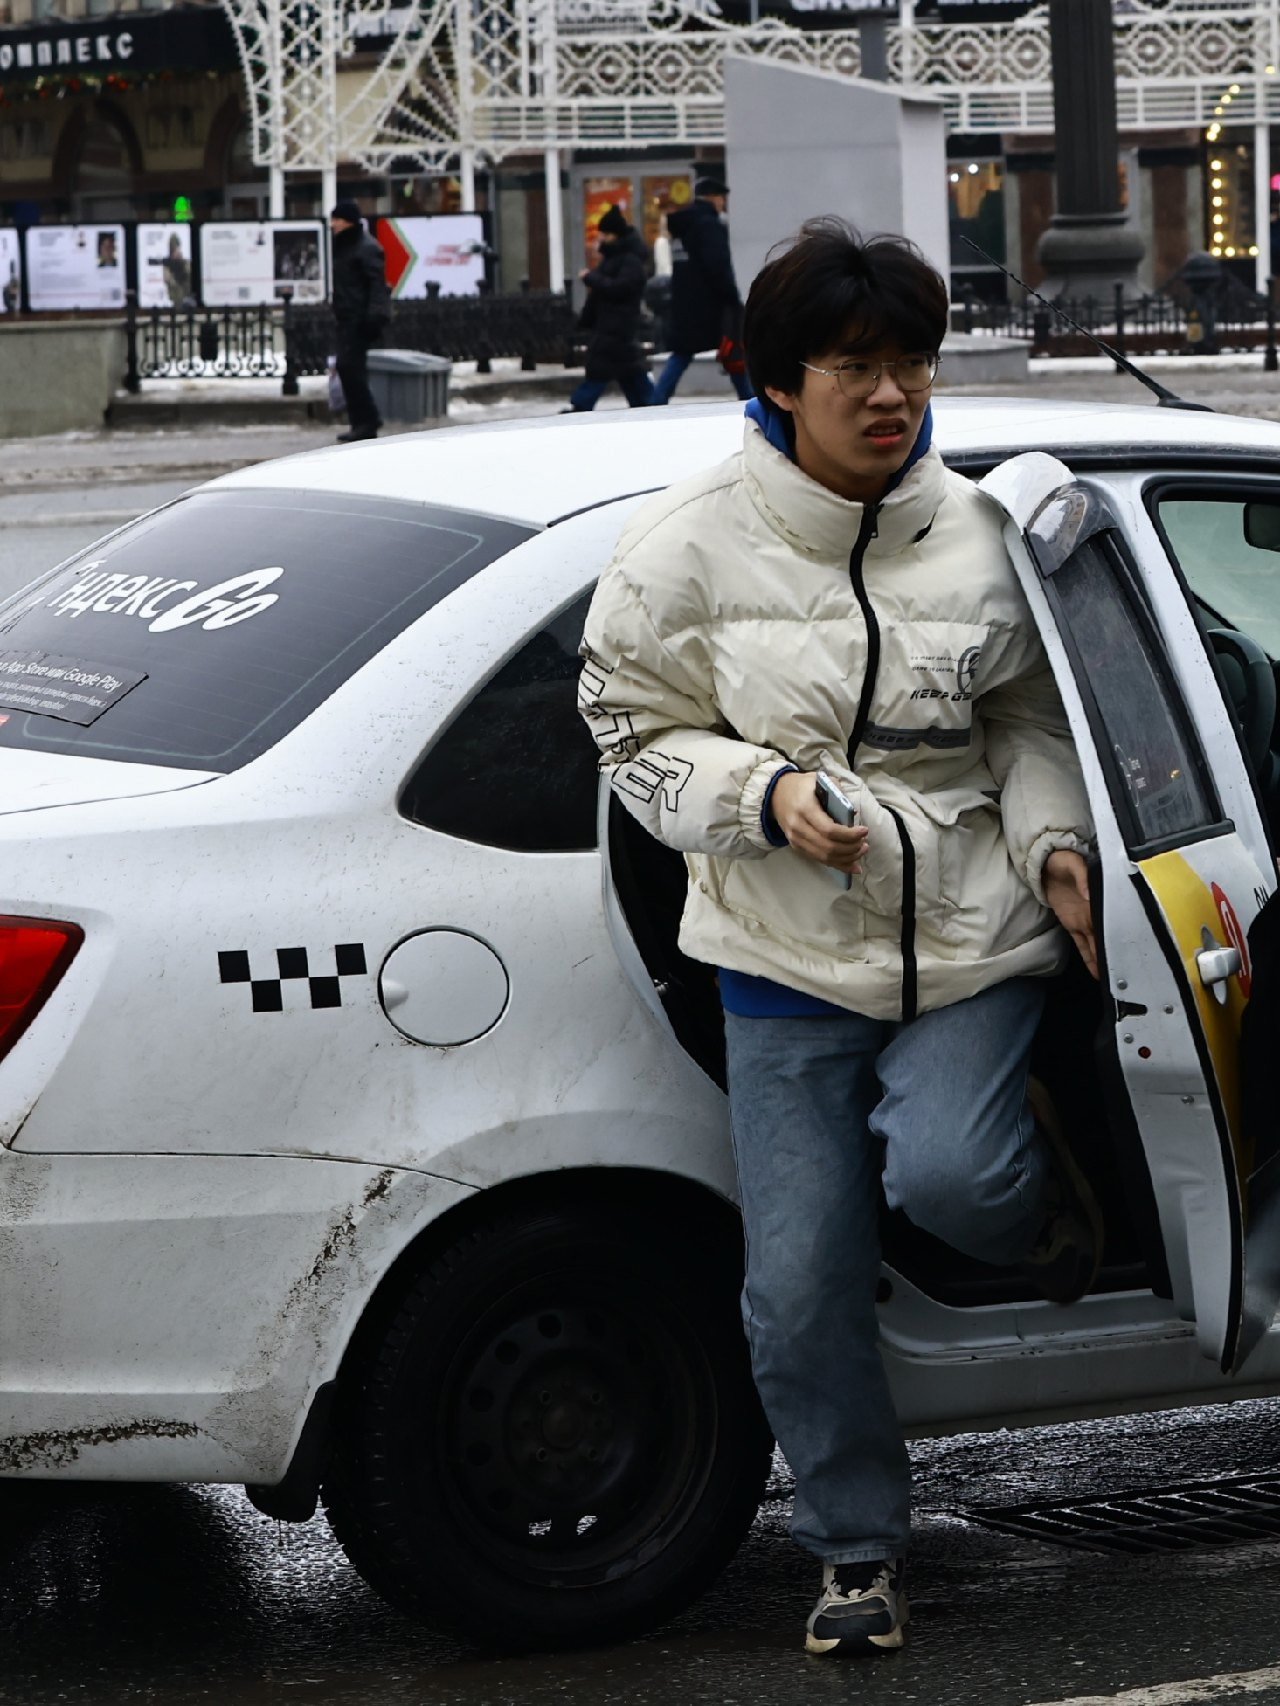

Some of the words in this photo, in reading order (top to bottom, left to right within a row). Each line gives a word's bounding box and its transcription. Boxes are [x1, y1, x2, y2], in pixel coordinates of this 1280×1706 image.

[148, 567, 285, 633] Go
[22, 662, 49, 676] Store
[63, 668, 101, 686] Google
[97, 674, 123, 693] Play
[910, 688, 949, 700] KEEP
